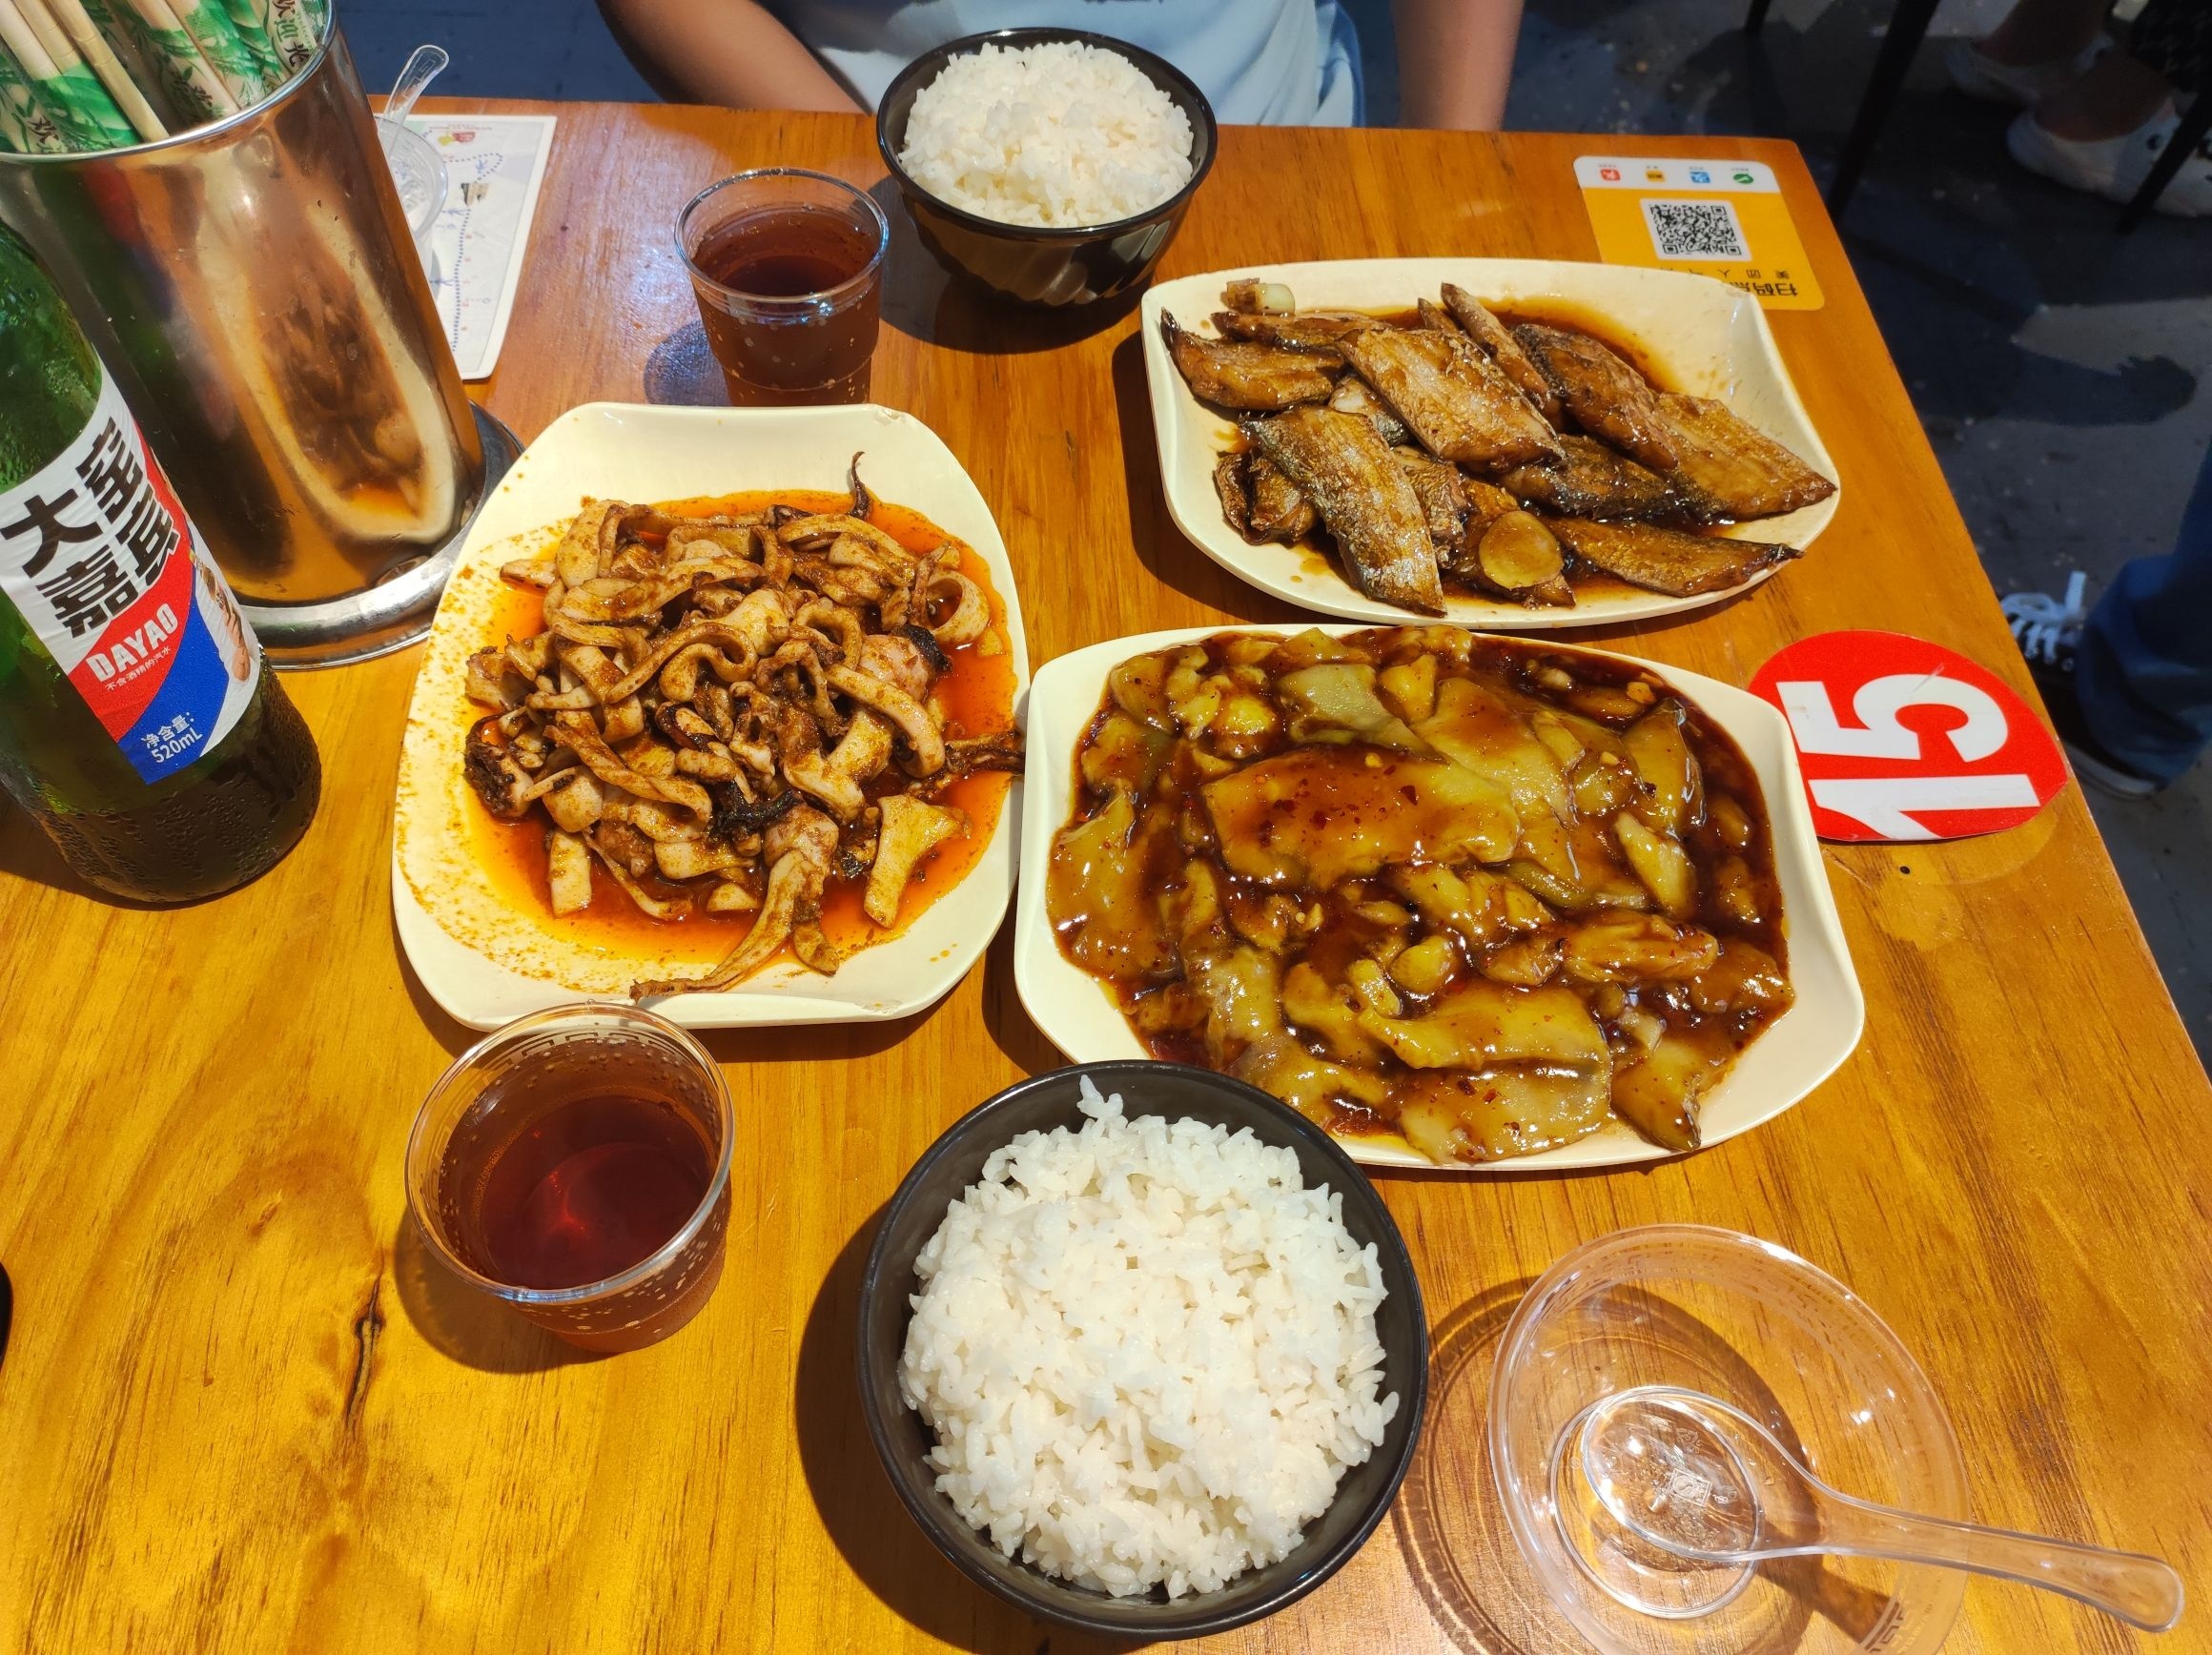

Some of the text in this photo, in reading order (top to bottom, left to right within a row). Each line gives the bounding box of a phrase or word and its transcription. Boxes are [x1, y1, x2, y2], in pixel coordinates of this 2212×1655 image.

[0, 416, 144, 579] 大窑
[35, 482, 179, 640] 嘉宾
[85, 603, 179, 683] DAYAO
[105, 645, 172, 691] 不含酒精的汽水
[151, 726, 203, 764] 520mL
[1775, 673, 2041, 840] 15
